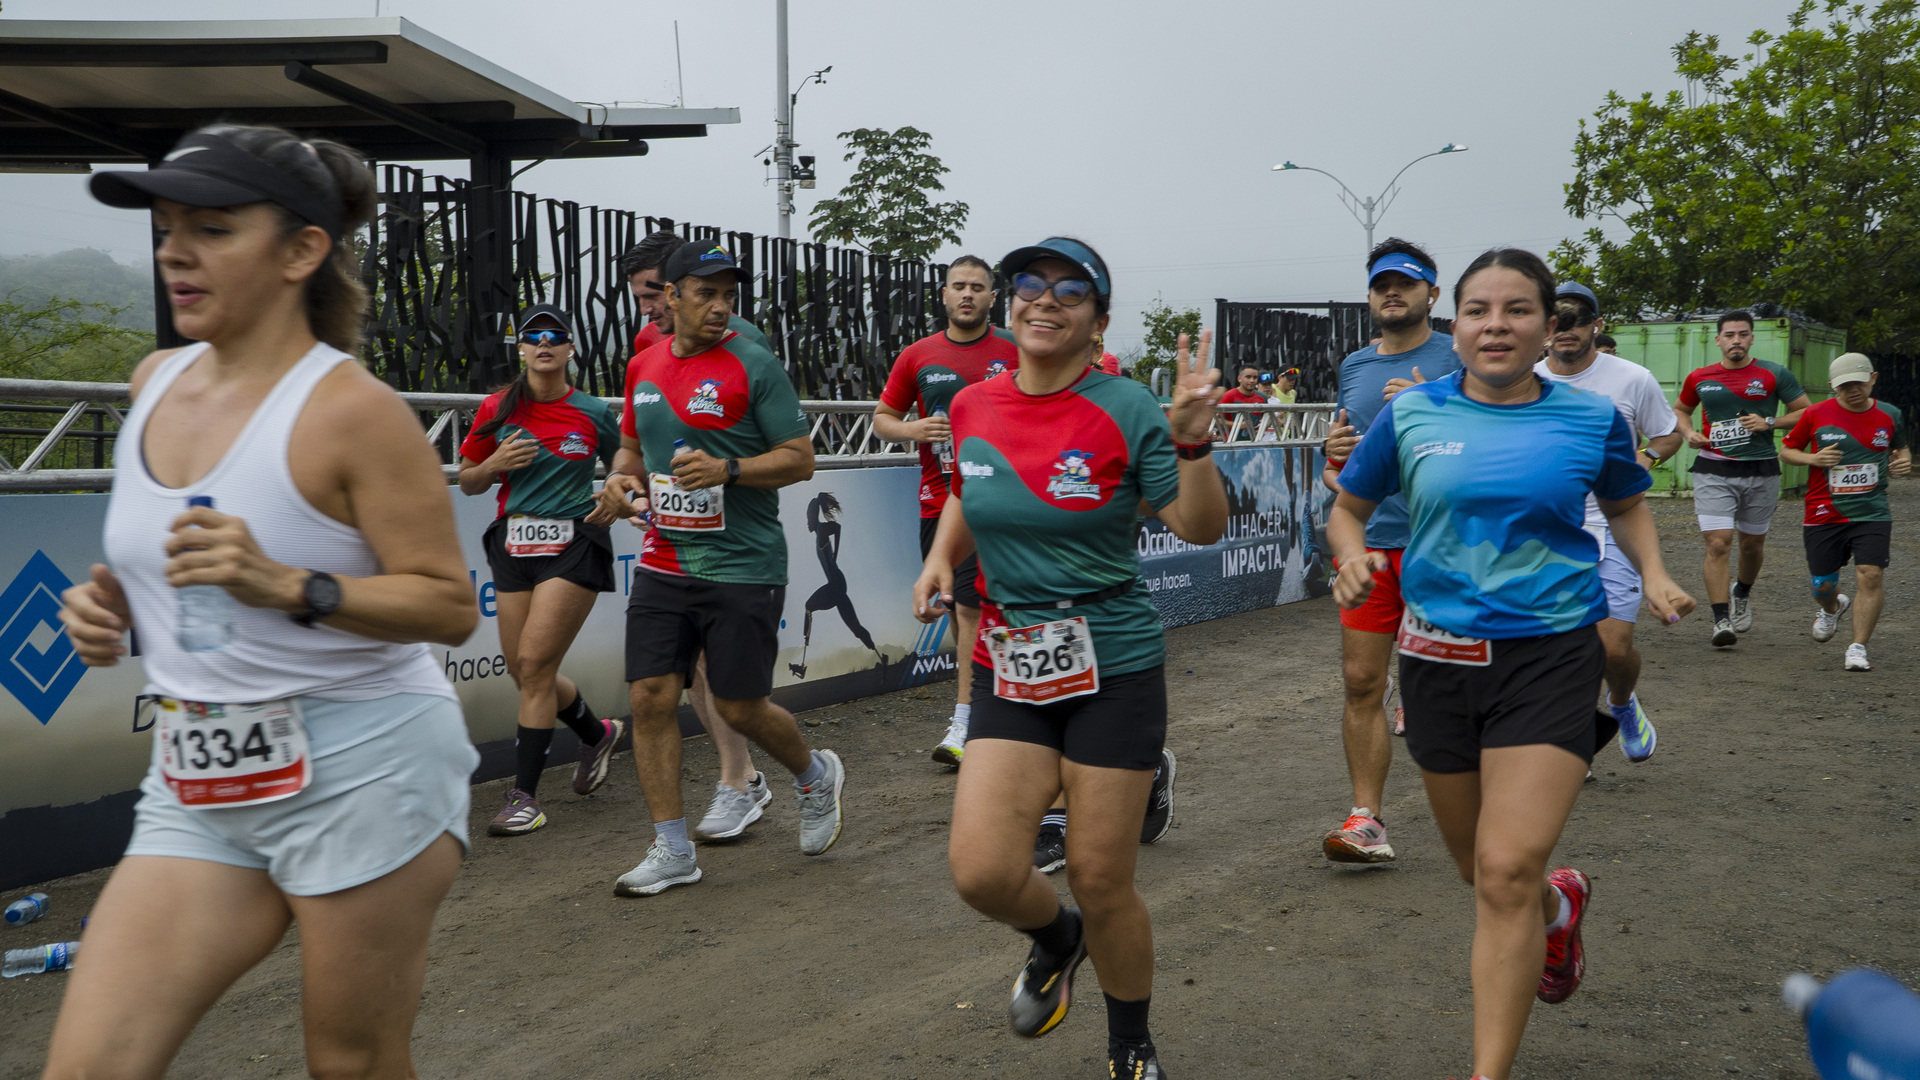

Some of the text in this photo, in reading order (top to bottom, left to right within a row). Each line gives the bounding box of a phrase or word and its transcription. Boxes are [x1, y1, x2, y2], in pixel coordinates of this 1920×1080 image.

[1716, 426, 1746, 440] 6218
[1842, 473, 1868, 484] 408
[515, 524, 560, 542] 1063
[1240, 510, 1285, 539] HACER,
[1222, 543, 1286, 578] IMPACTA.
[1162, 570, 1192, 590] hacen.
[445, 650, 510, 682] hace
[912, 653, 954, 676] AVAL
[172, 721, 273, 771] 1334
